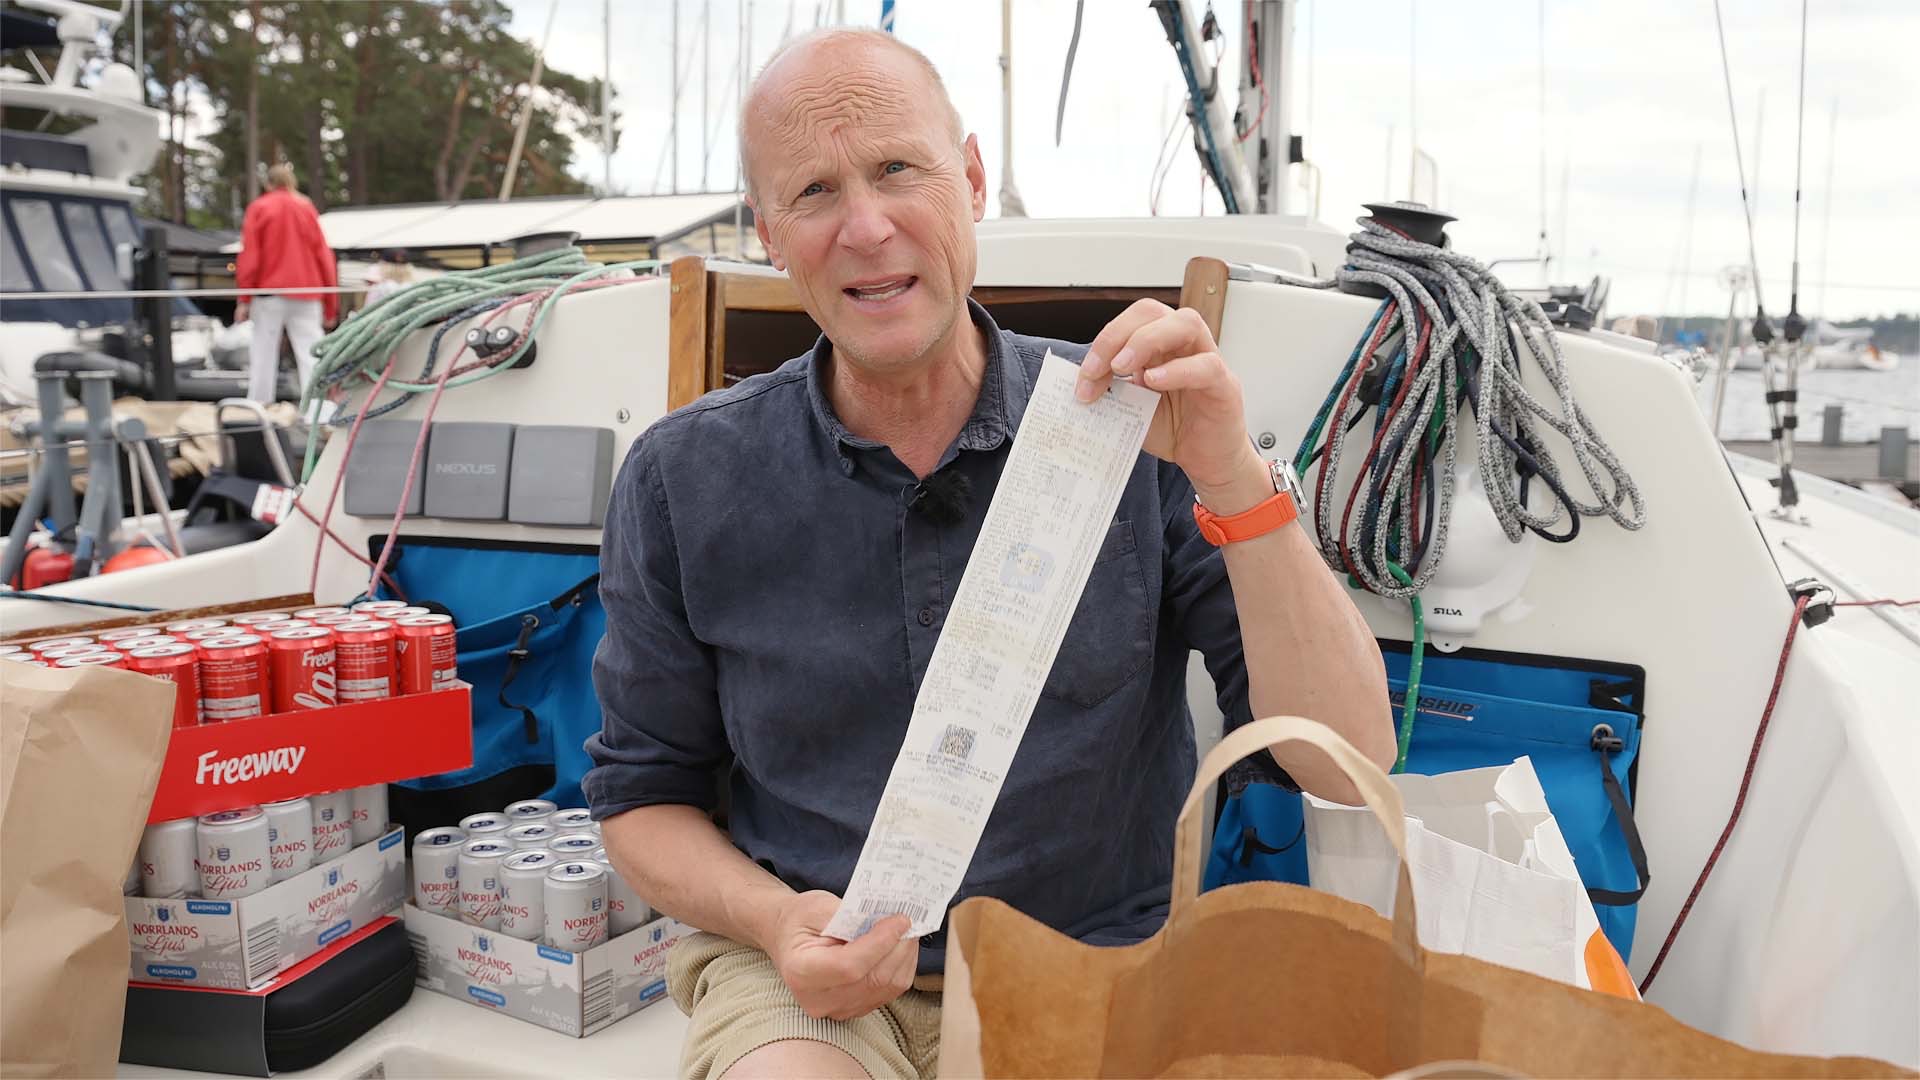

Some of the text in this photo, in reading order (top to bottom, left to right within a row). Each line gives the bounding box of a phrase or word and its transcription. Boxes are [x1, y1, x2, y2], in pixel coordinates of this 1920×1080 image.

[435, 463, 497, 474] NEXUS
[1433, 607, 1463, 616] SILVA
[196, 746, 306, 785] Freeway
[205, 875, 248, 896] Ljus
[308, 880, 358, 913] NORRLANDS
[133, 923, 199, 939] NORRLANDS
[144, 935, 185, 955] Ljus
[458, 948, 513, 976] NORRLANDS
[466, 964, 502, 985] Ljus
